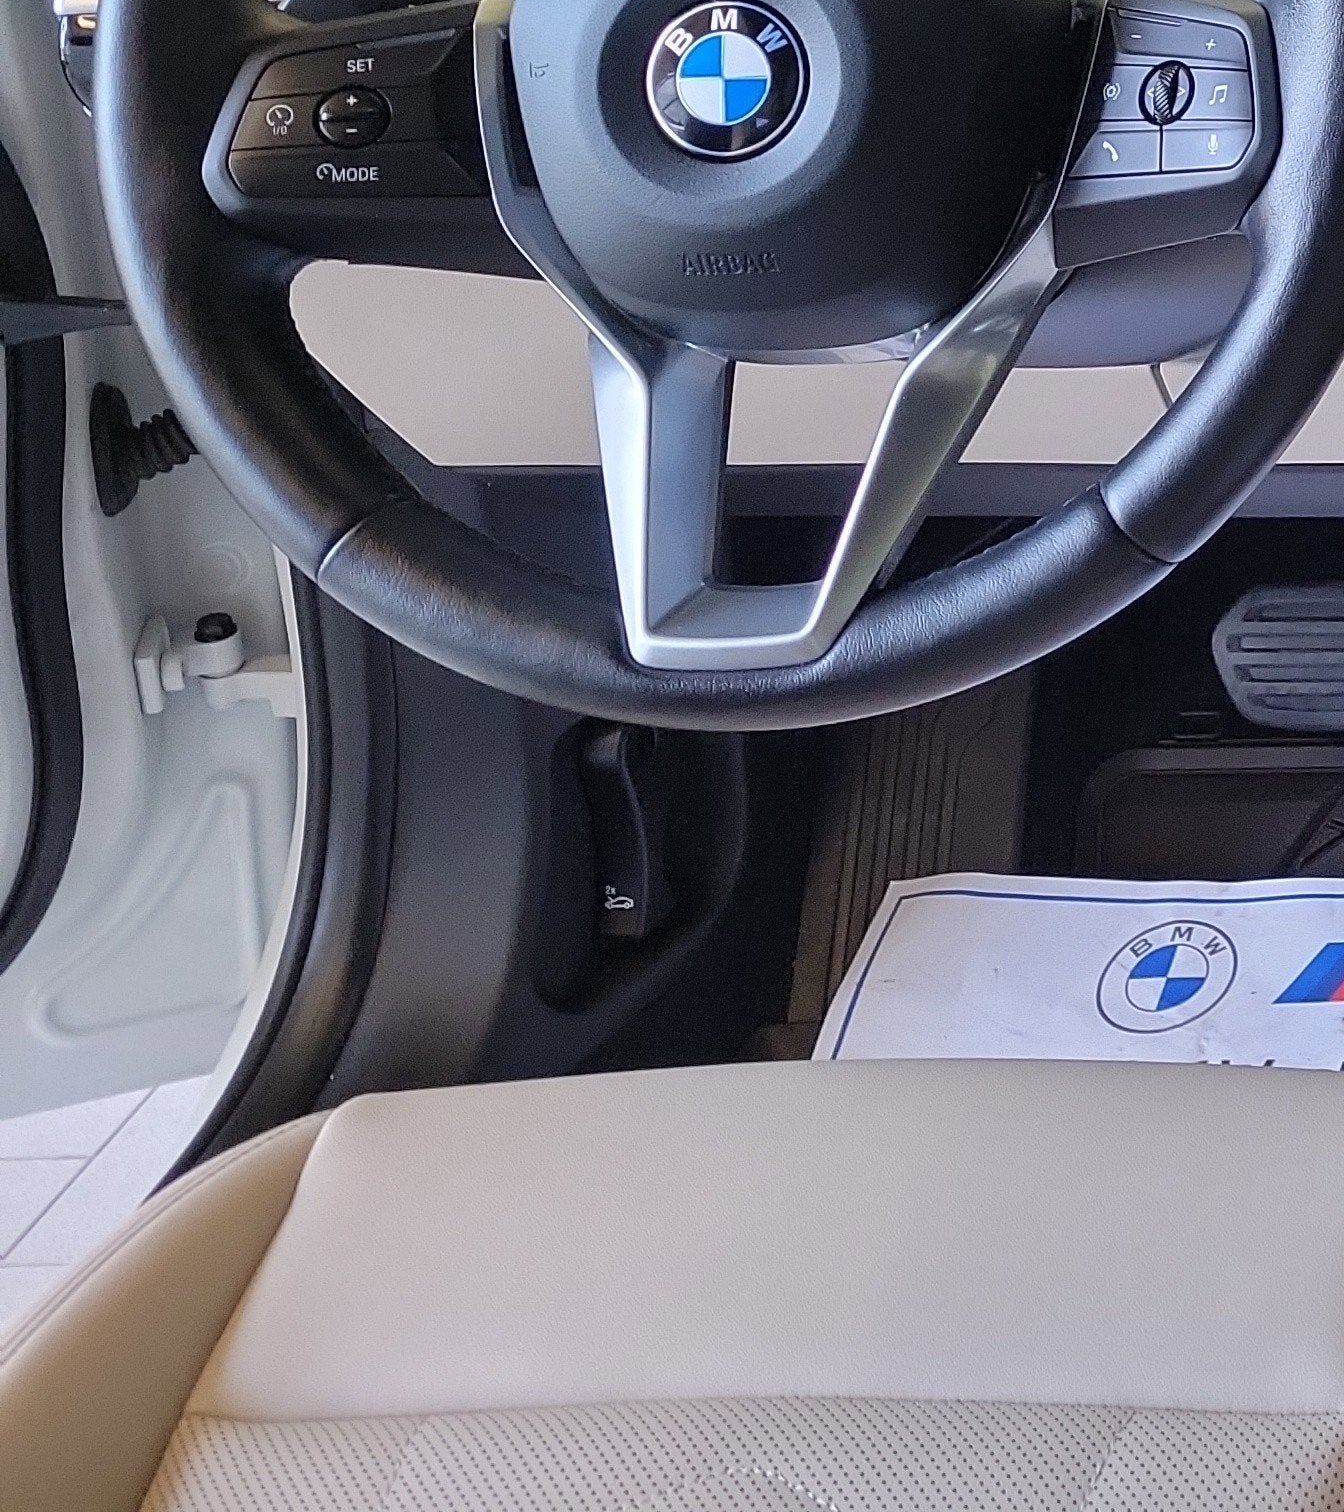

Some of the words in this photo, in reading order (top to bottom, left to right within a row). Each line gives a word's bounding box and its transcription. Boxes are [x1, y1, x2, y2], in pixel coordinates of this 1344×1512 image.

[664, 8, 788, 57] BMW
[346, 57, 375, 73] SET
[331, 166, 379, 181] MODE
[681, 252, 779, 276] AIRBAG
[1128, 924, 1228, 959] BMW
